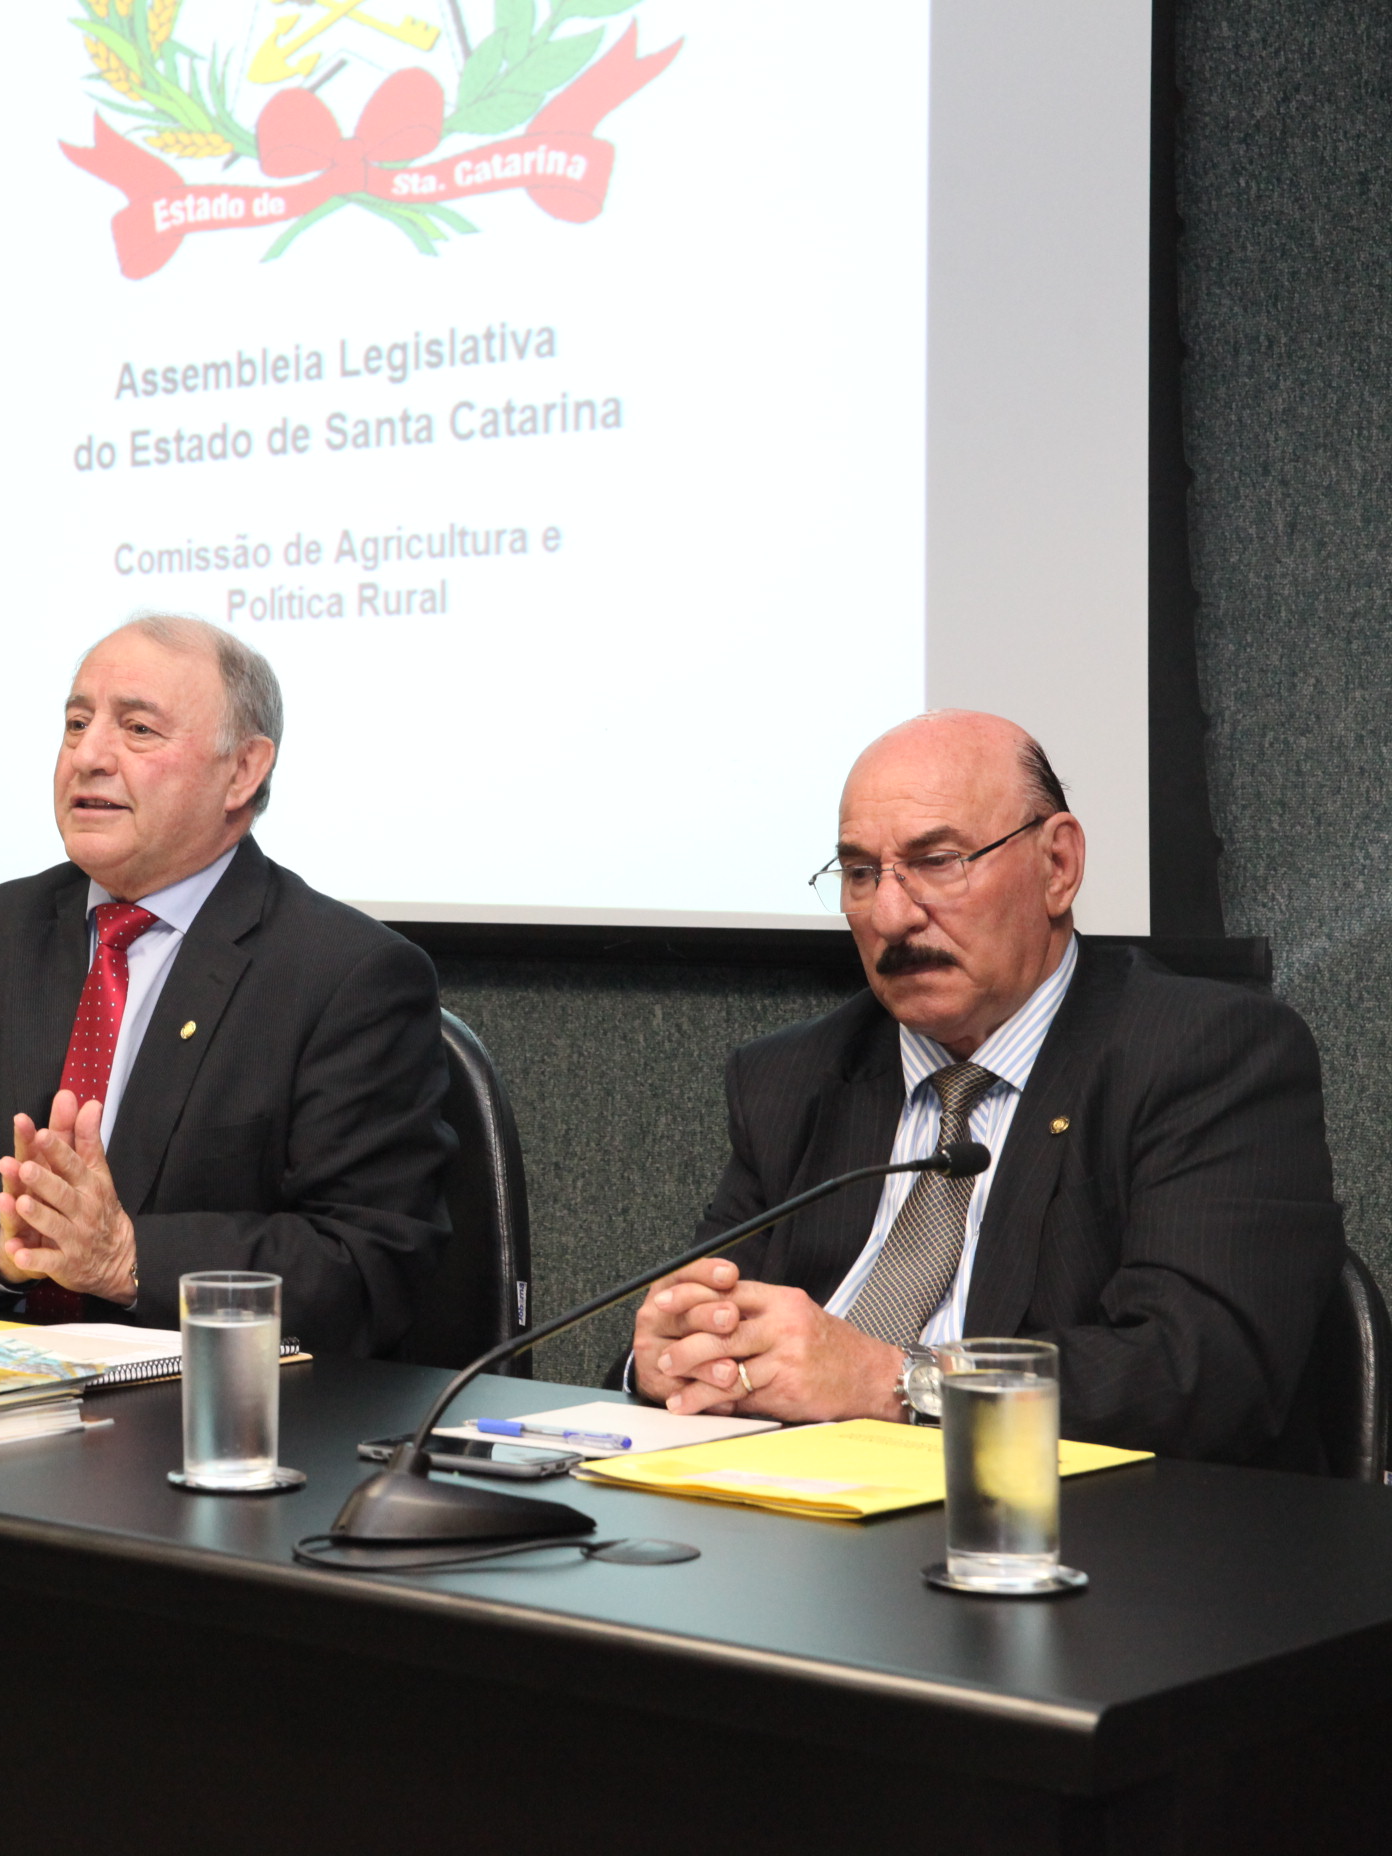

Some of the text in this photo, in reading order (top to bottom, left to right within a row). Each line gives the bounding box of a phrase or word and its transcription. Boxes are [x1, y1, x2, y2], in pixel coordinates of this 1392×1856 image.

[153, 145, 588, 233] Estado de Sta. Catarina
[114, 322, 558, 400] Assembleia Legislativa
[73, 393, 624, 473] do Estado de Santa Catarina
[114, 523, 563, 576] Comissão de Agricultura e
[226, 580, 449, 622] Política Rural
